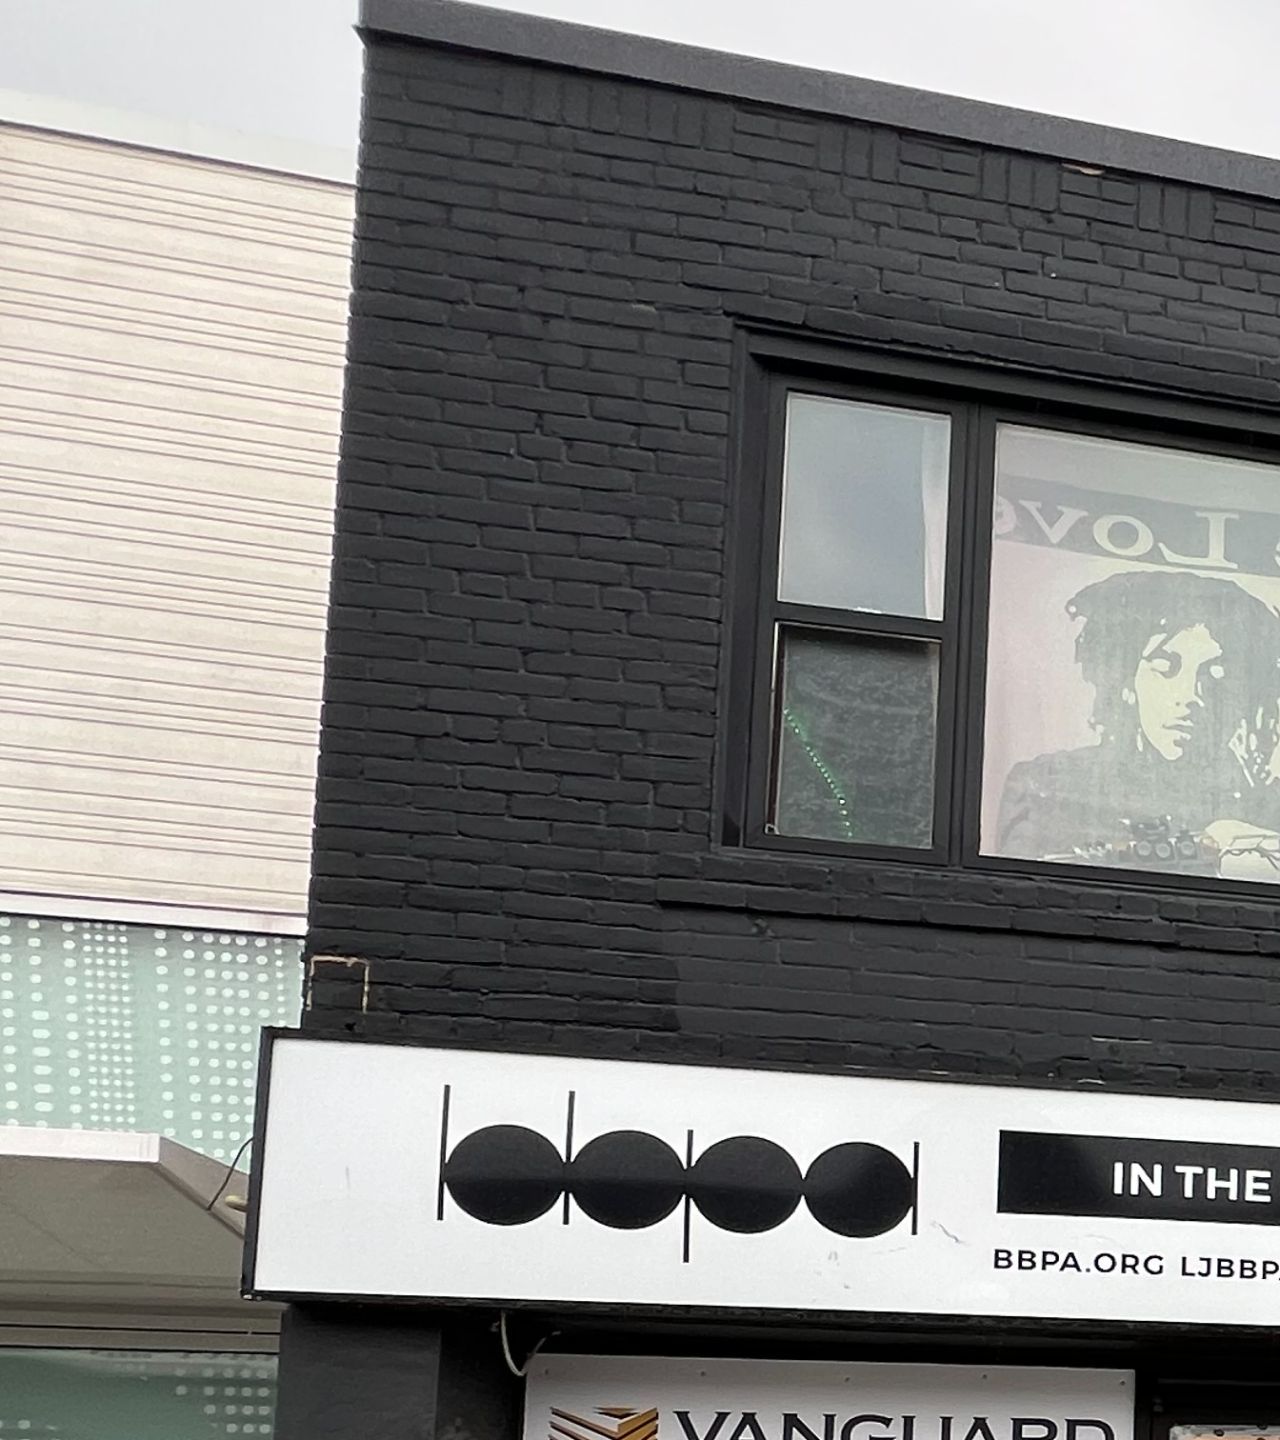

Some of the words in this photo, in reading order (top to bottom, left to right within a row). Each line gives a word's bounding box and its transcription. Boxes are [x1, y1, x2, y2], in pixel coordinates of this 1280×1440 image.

[1112, 1161, 1164, 1197] IN
[1175, 1165, 1272, 1202] THE
[992, 1248, 1165, 1276] BBPA.ORG
